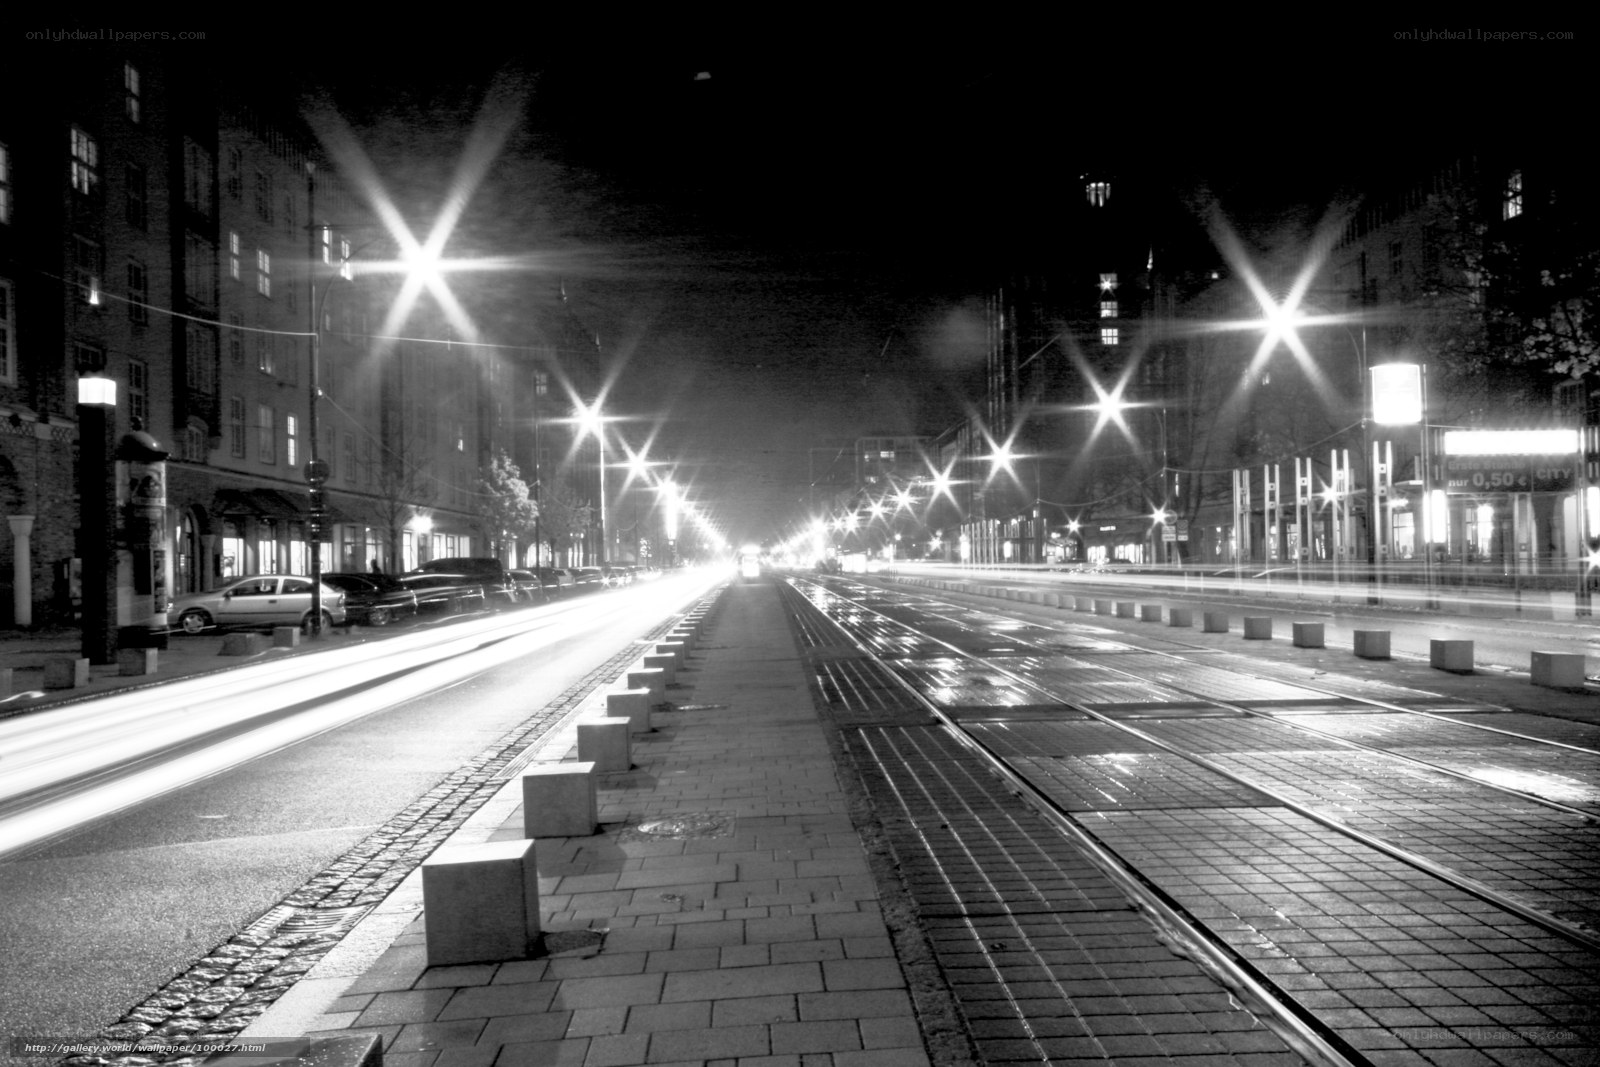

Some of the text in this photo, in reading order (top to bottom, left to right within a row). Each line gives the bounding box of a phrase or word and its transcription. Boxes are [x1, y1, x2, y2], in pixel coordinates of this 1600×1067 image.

[1537, 468, 1571, 479] CITY
[1448, 479, 1469, 487] nur
[1472, 473, 1514, 490] 0,50
